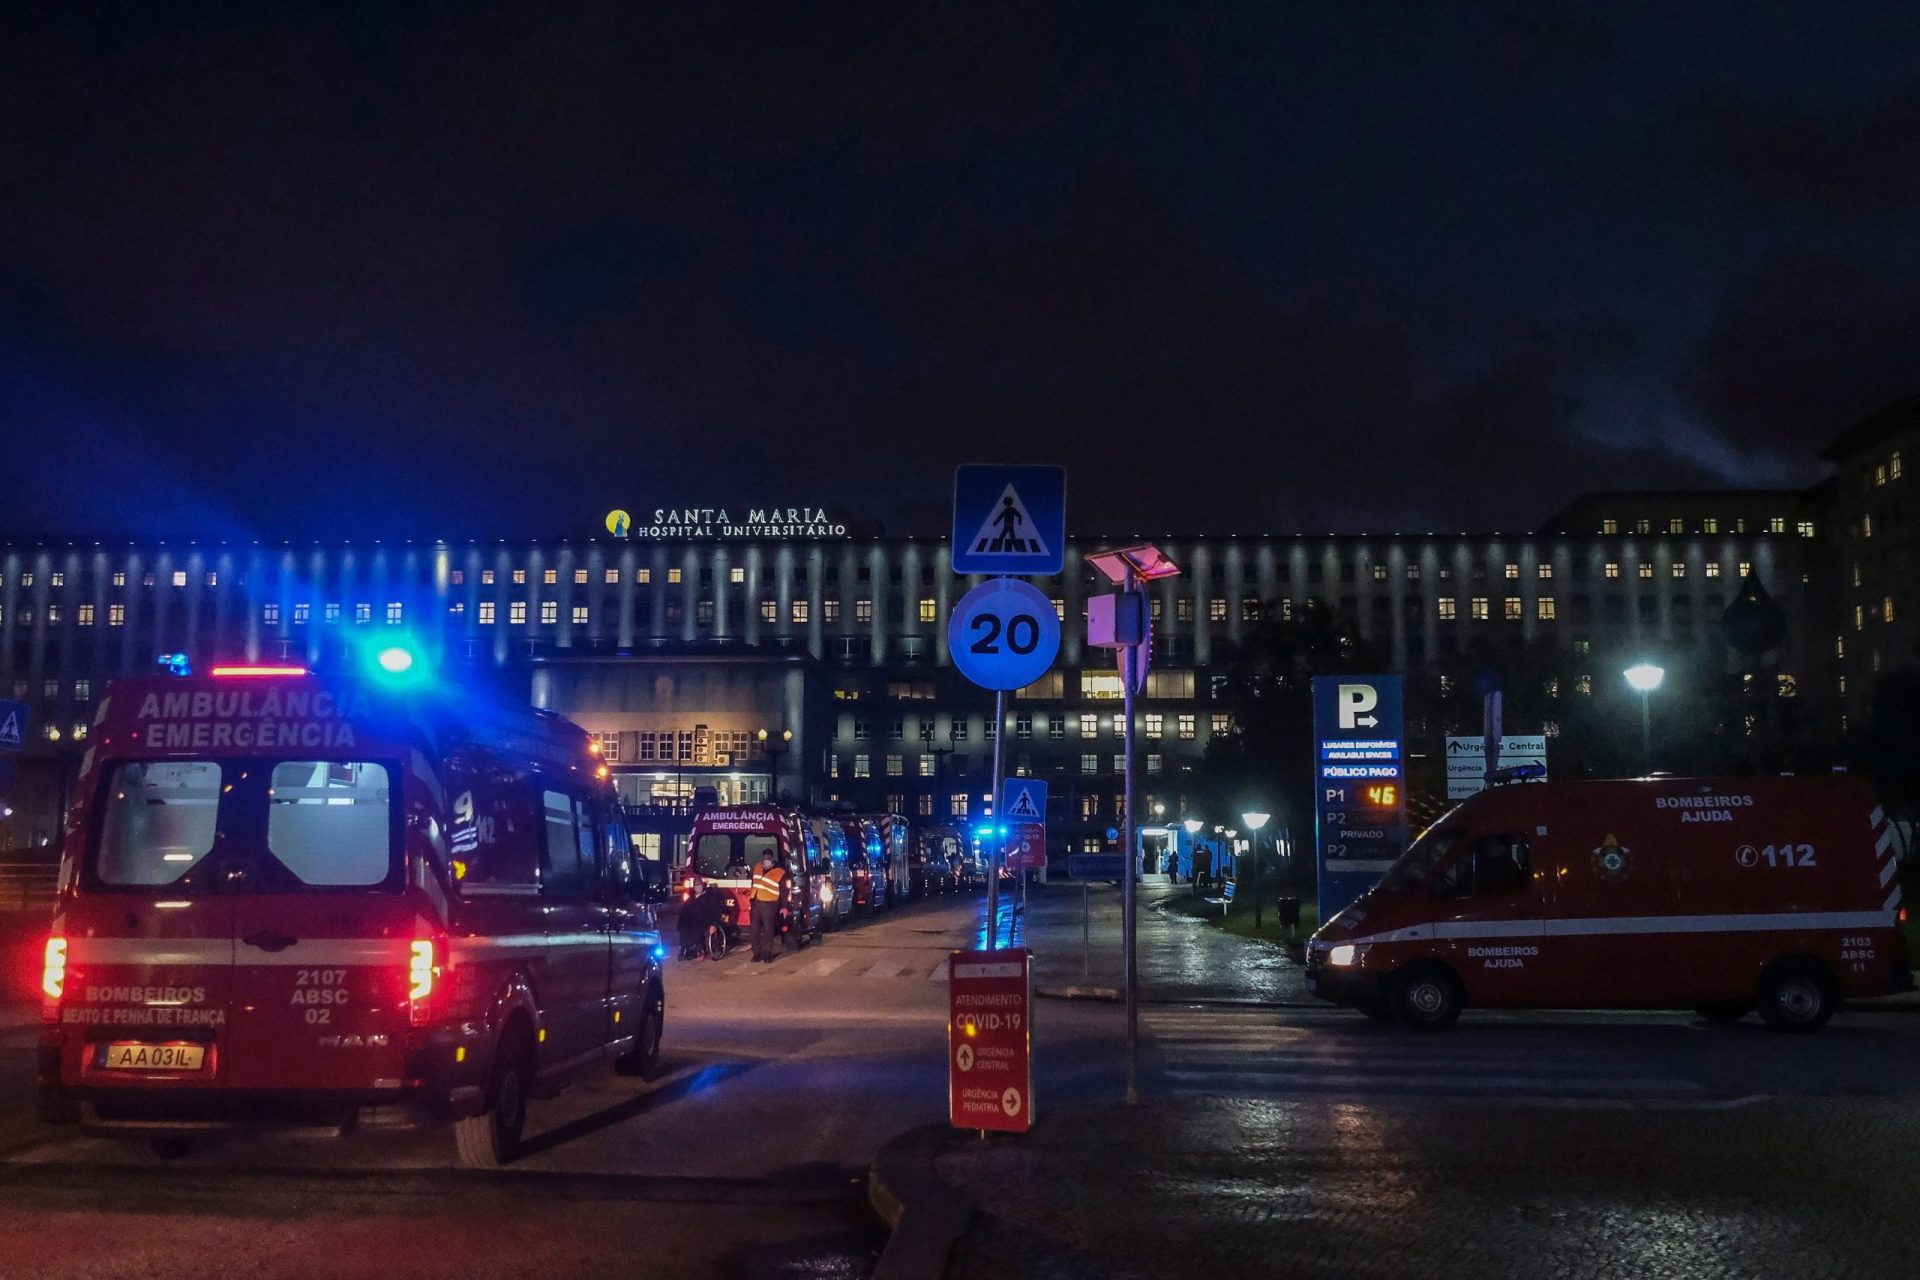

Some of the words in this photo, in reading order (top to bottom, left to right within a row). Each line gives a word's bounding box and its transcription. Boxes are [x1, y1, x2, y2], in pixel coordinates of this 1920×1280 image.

[655, 508, 730, 524] SANTA
[748, 508, 828, 524] MARIA
[639, 526, 712, 537] HOSPITAL
[723, 523, 846, 537] UNIVERSITÁRIO
[970, 613, 1039, 655] 20
[138, 688, 371, 719] AMBULÂNCIA
[1338, 684, 1378, 729] P
[146, 719, 356, 748] EMERGÊNCIA
[1323, 741, 1354, 749] LUGARES
[1508, 741, 1544, 751] Central
[1365, 751, 1392, 759] SPACES
[1323, 766, 1367, 777] PÚBLICO
[1368, 767, 1398, 777] PAGO
[1448, 764, 1482, 774] Urgência
[1326, 789, 1345, 802] P1
[1369, 786, 1394, 805] 46
[1656, 795, 1754, 809] BOMBEIROS
[703, 811, 775, 821] AMBULÂNCIA
[1326, 812, 1346, 825] P2
[1681, 810, 1733, 823] AJUDA
[712, 820, 764, 830] EMERGÊNCIA
[1340, 830, 1384, 839] PRIVADO
[1327, 844, 1347, 857] P2
[1761, 843, 1817, 867] 112
[1841, 937, 1872, 947] 2103
[1467, 946, 1539, 957] BOMBEIROS
[1840, 950, 1875, 960] ABSC
[1484, 959, 1524, 968] AJUDA
[1852, 963, 1865, 972] 11
[296, 969, 347, 986] 2107
[85, 986, 206, 1003] BOMBEIROS
[290, 989, 349, 1005] ABSC
[956, 994, 1022, 1006] ATENDIMENTO
[63, 1008, 100, 1024] BEATO
[102, 1008, 111, 1023] E
[113, 1008, 153, 1024] PENHA
[156, 1008, 174, 1024] DE
[176, 1009, 226, 1028] FRANÇA
[305, 1008, 331, 1024] 02
[956, 1013, 1021, 1031] COVID-19
[976, 1046, 1015, 1058] URGÊNCIA
[976, 1061, 1010, 1071] CENTRAL
[962, 1087, 999, 1100] URGÊNCIA
